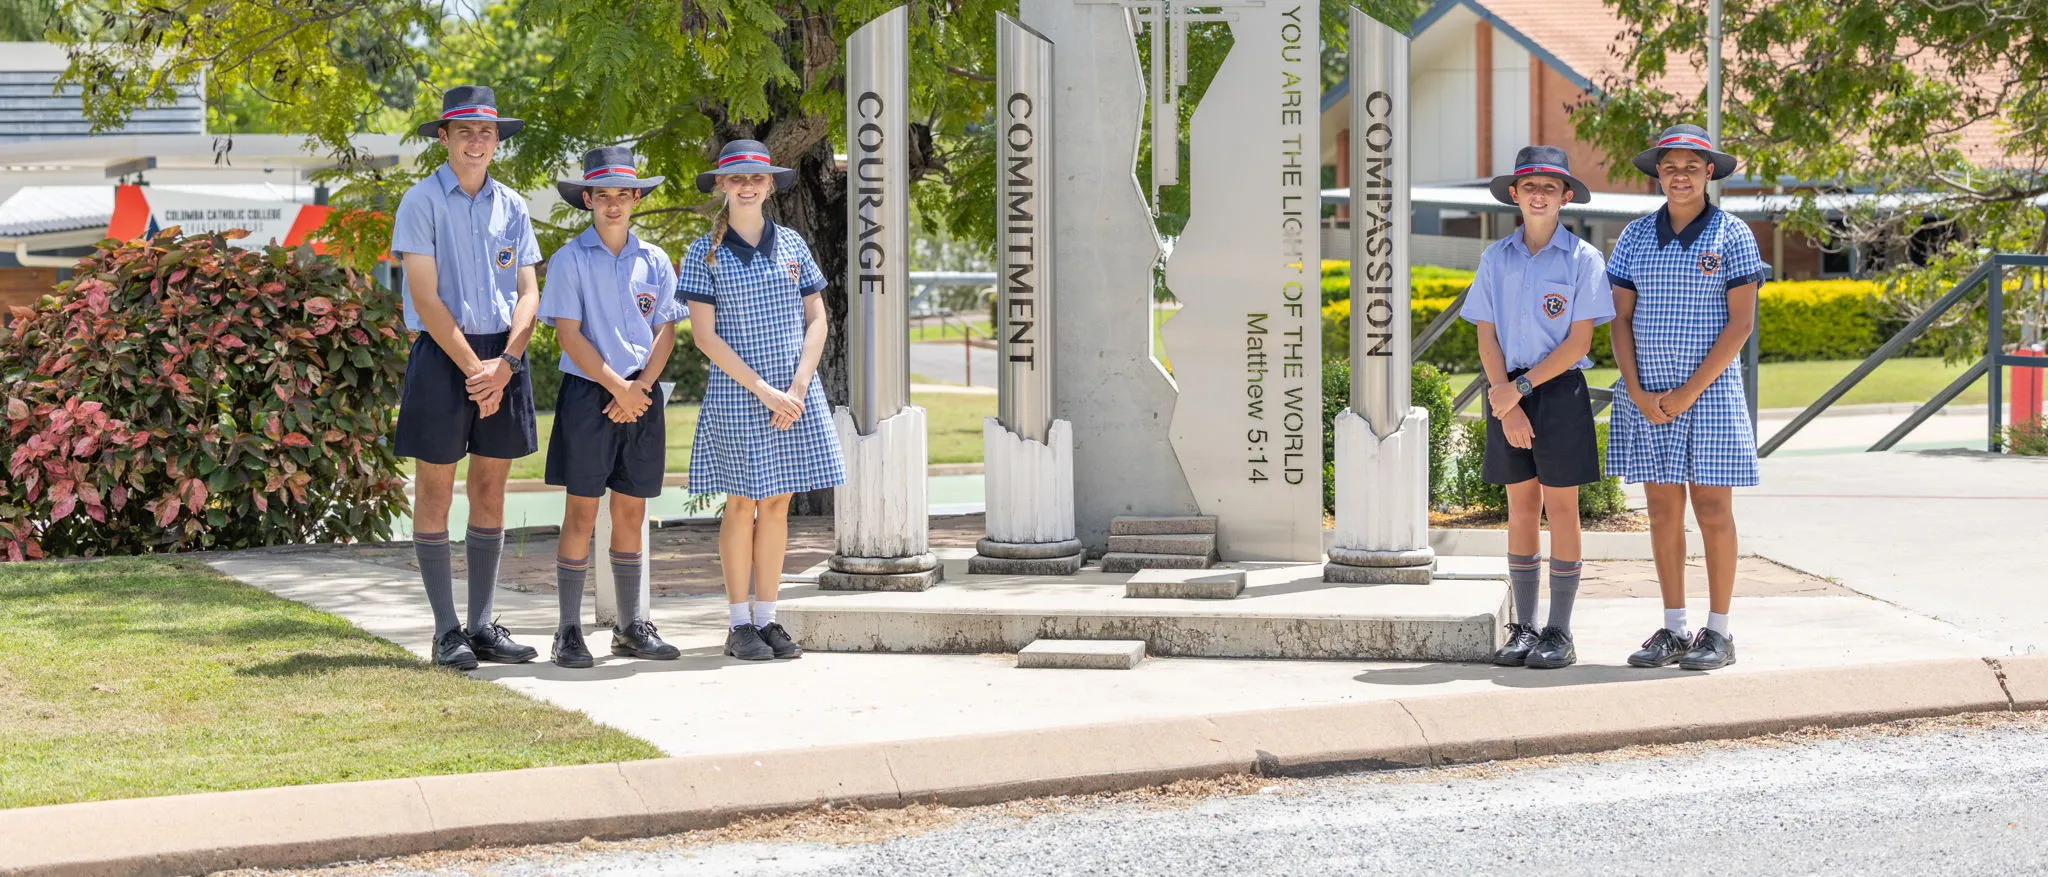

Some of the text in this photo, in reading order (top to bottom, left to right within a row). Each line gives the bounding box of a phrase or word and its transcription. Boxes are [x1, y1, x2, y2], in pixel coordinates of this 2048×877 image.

[165, 208, 281, 221] COLUMBA CATHOLIC COLLEGE
[857, 91, 885, 295] COURAGE
[1007, 92, 1034, 371] COMMITMENT
[1281, 6, 1304, 485] YOU ARE THE LIGHT OF THE WORLD
[1365, 90, 1393, 357] COMPASSION
[1247, 313, 1268, 483] Matthew 5:14
